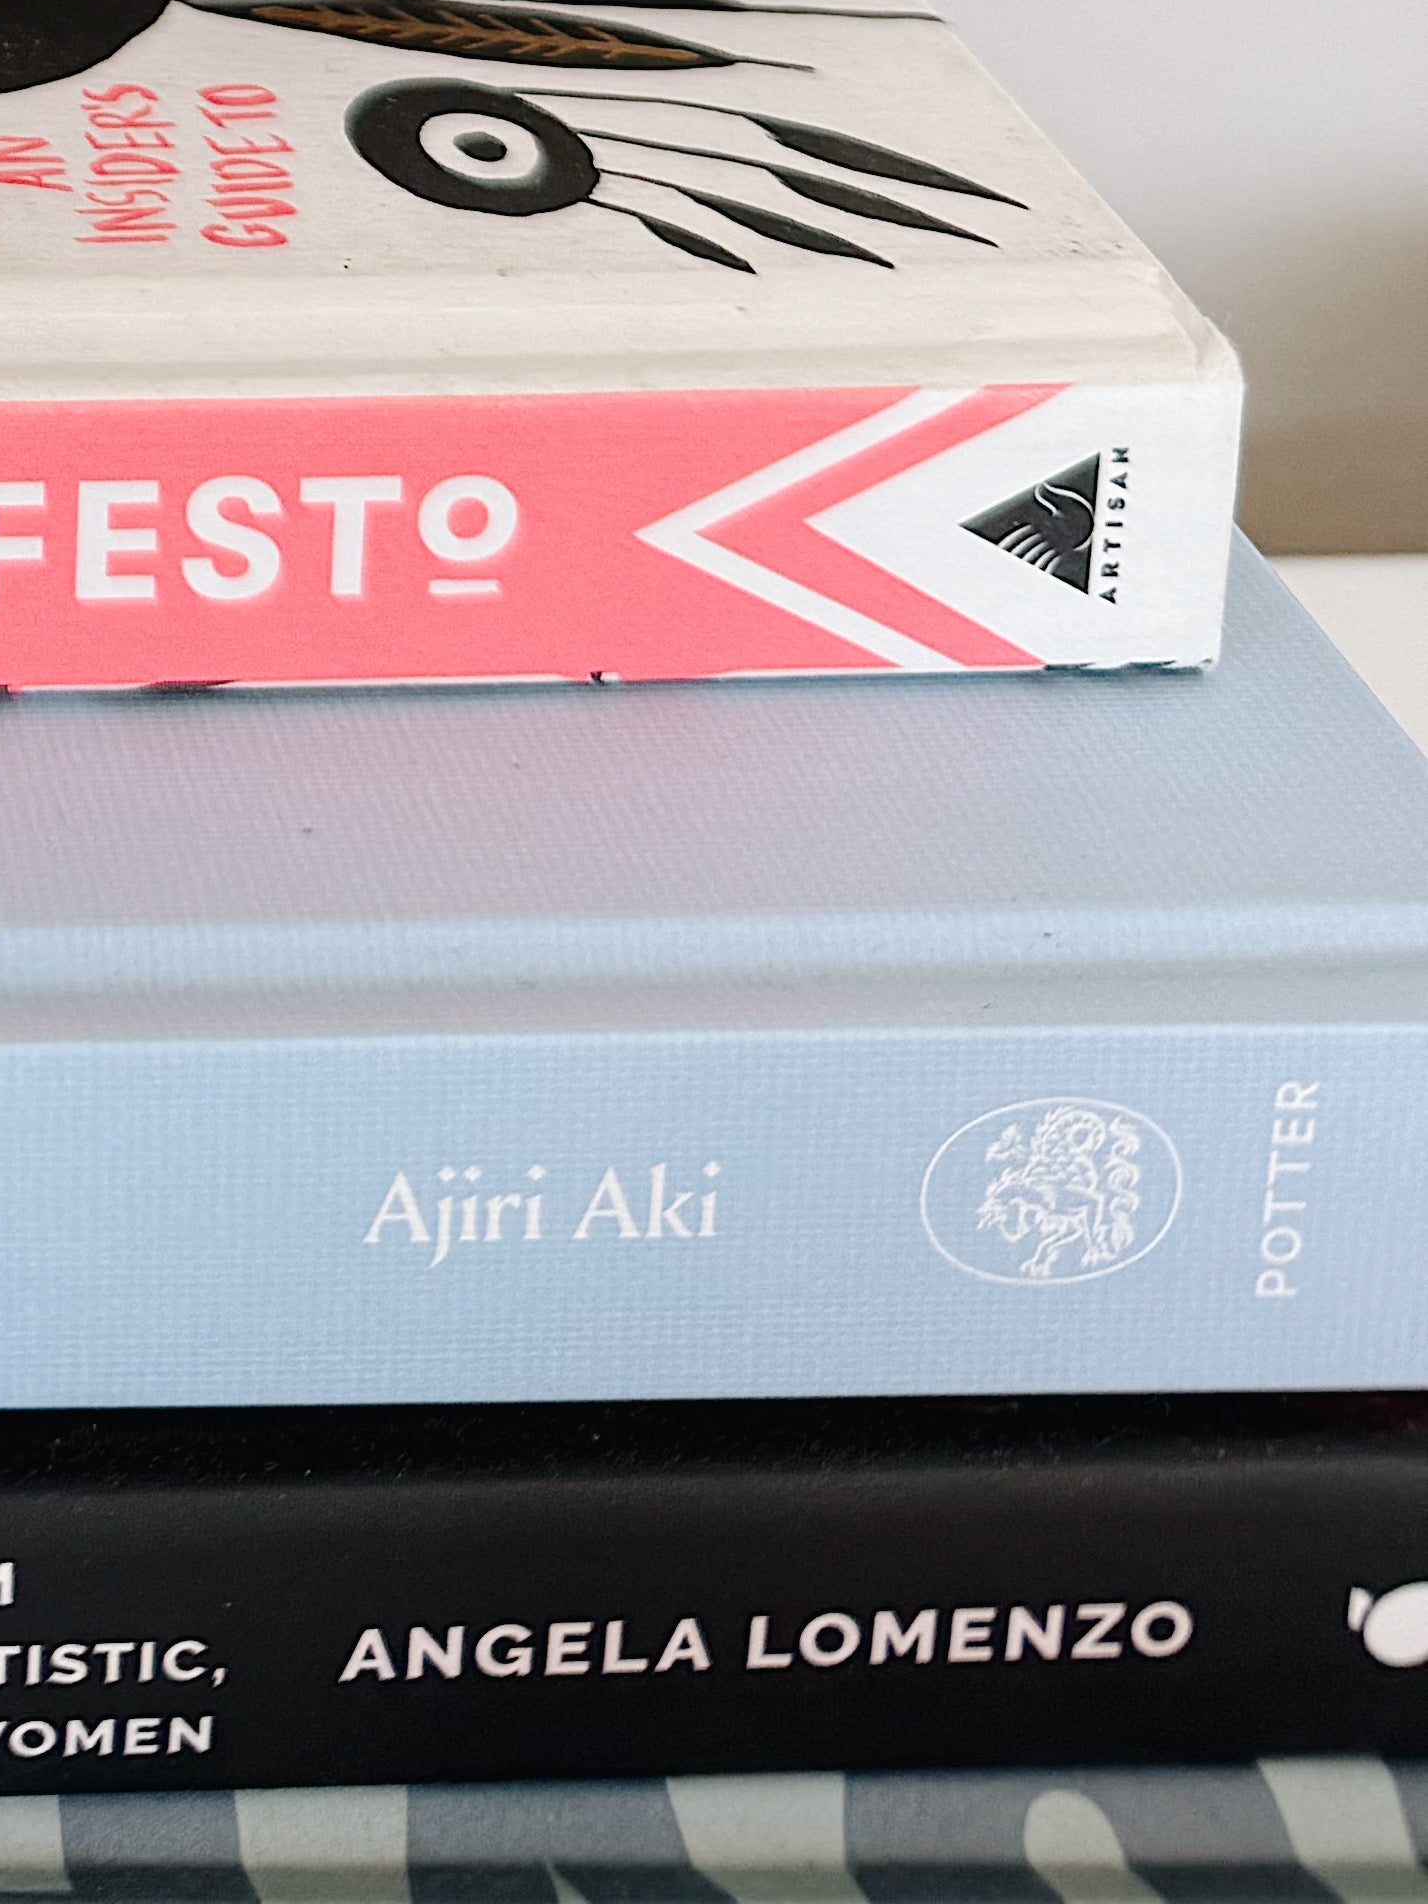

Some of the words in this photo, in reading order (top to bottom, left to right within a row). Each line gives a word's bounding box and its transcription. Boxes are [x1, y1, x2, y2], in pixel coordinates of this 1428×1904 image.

[74, 83, 182, 244] INSIDER'S
[196, 82, 278, 129] TO
[200, 132, 298, 248] GUIDE
[1098, 446, 1130, 605] ARTISAN
[362, 1162, 546, 1269] Ajiri
[573, 1159, 722, 1240] Aki
[1254, 1080, 1320, 1299] POTTER
[339, 1619, 713, 1683] ANGELA
[746, 1600, 1195, 1672] LOMENZO
